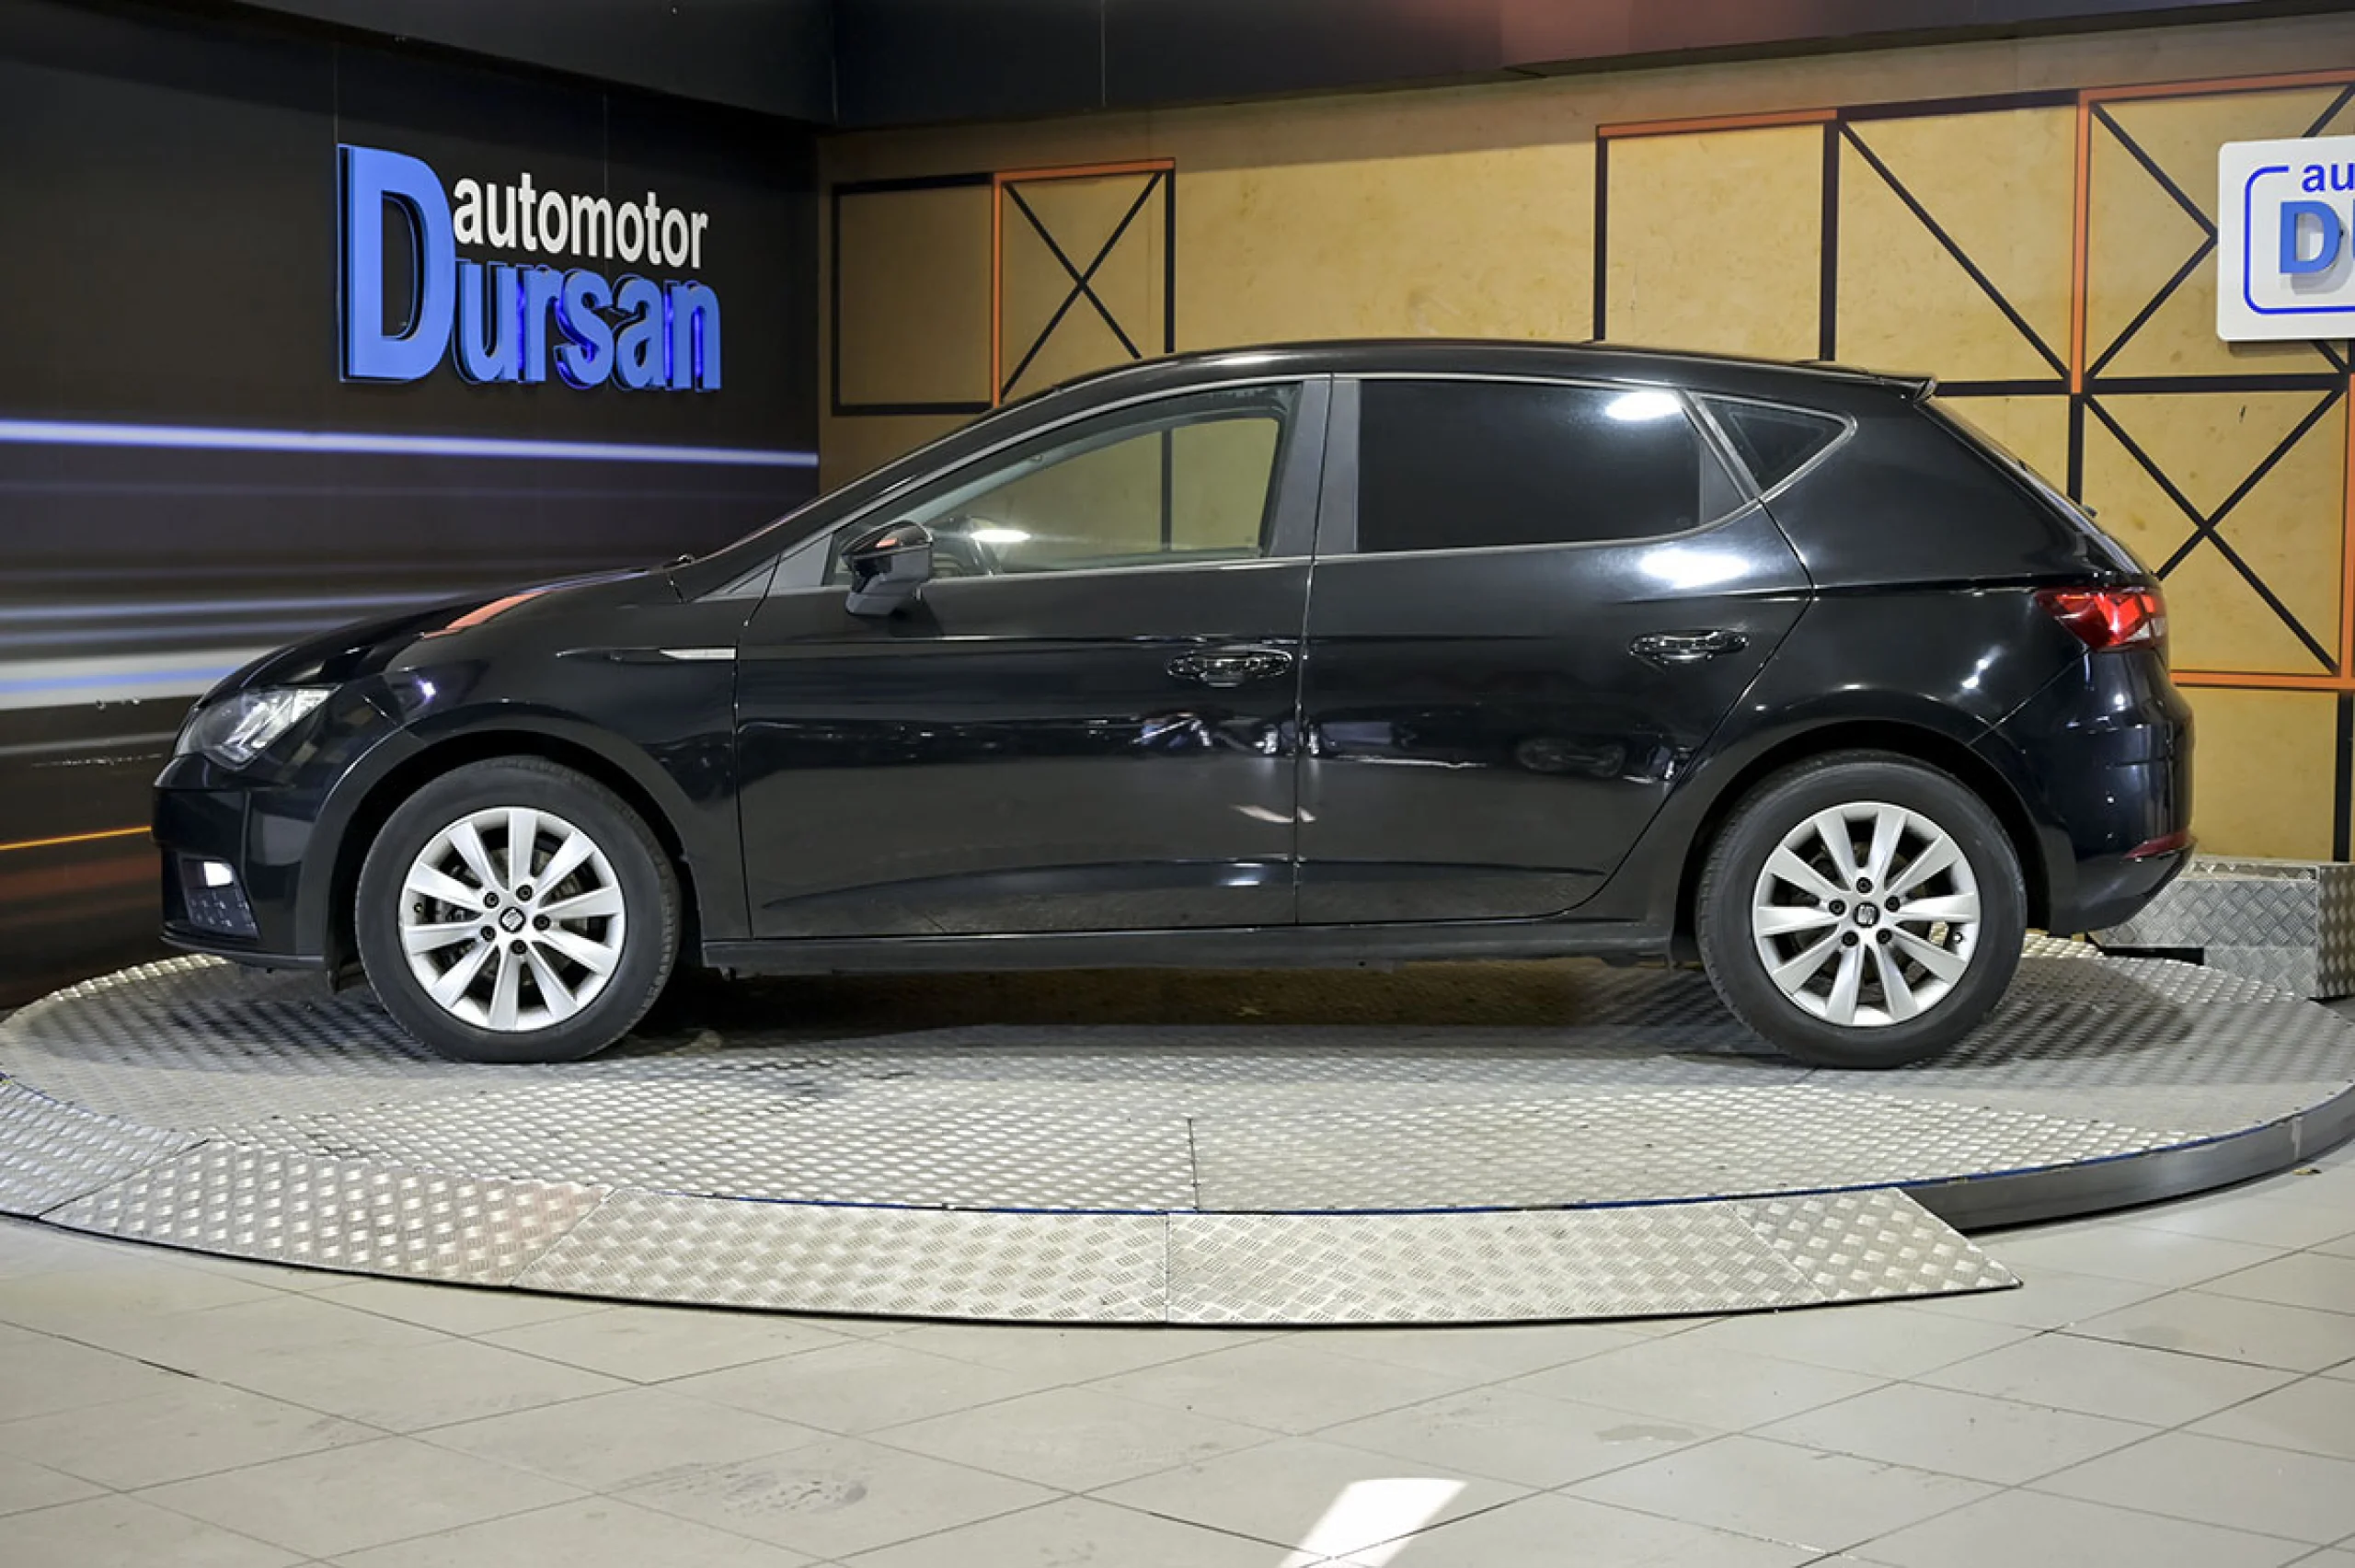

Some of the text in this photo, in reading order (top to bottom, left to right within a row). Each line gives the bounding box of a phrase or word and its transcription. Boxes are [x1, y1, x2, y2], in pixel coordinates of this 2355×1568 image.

[337, 143, 722, 392] Dursan
[453, 173, 709, 269] automotor
[2279, 199, 2355, 274] D
